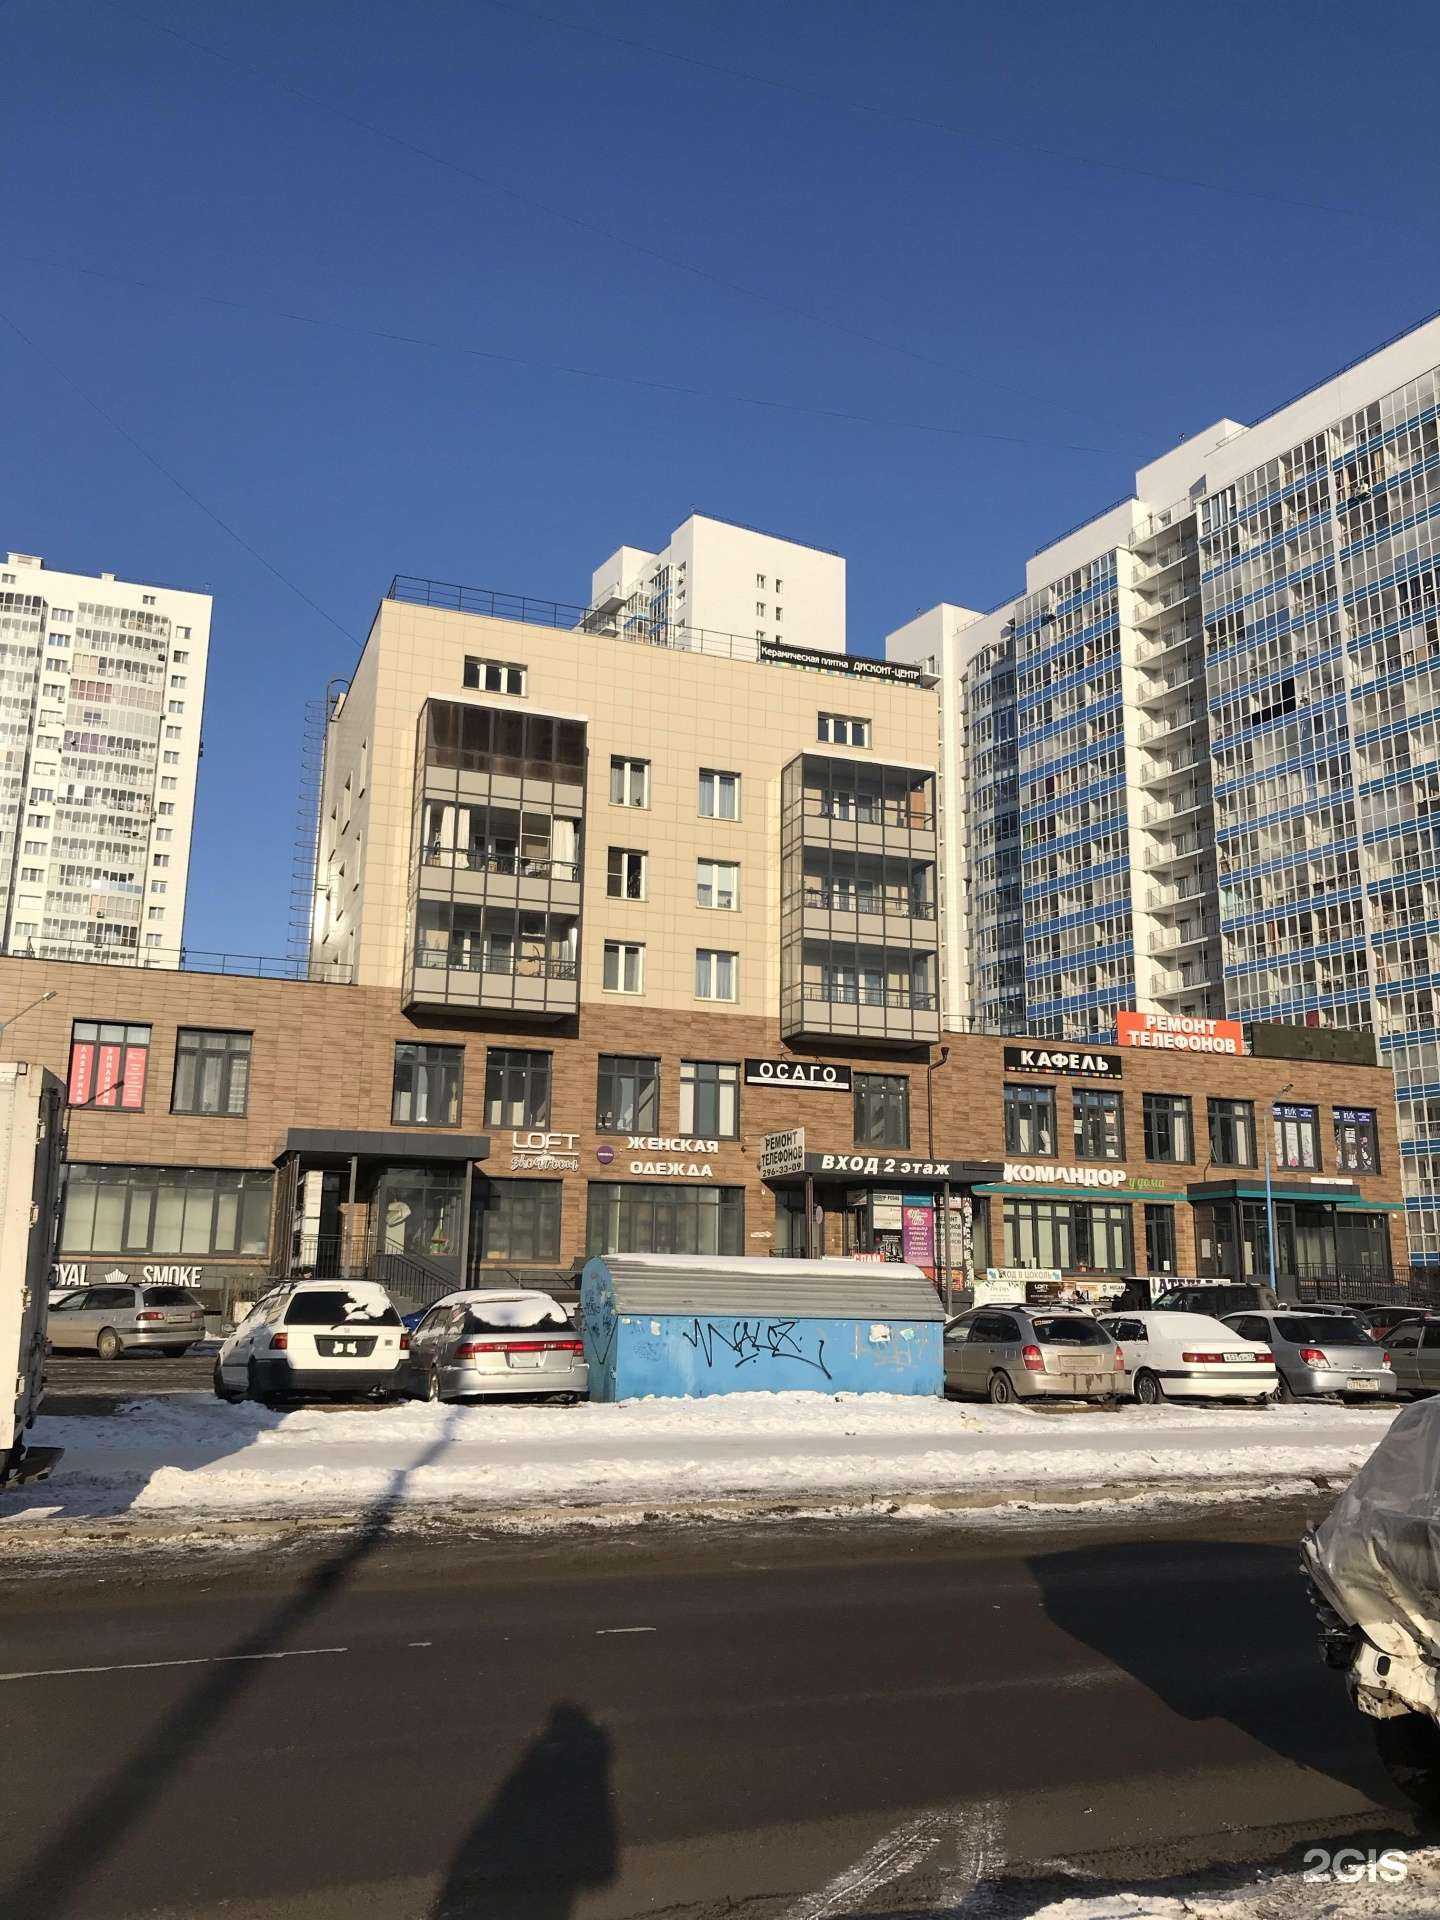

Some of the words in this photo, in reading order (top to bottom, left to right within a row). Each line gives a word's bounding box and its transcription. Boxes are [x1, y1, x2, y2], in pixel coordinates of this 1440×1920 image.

[761, 646, 820, 664] Керамическая
[821, 657, 849, 668] плитка
[1146, 1015, 1217, 1035] РЕМОНТ
[1128, 1030, 1236, 1054] ТЕЛЕФОНОВ
[1020, 1050, 1109, 1072] КАФЕЛЬ
[759, 1062, 837, 1082] ОСАГО
[513, 1131, 580, 1150] LOFT
[626, 1136, 719, 1154] ЖЕНСКАЯ
[765, 1130, 798, 1151] РЕМОНТ
[762, 1145, 803, 1167] ТЕЛЕФОНОВ
[821, 1154, 879, 1175] ВХОД
[883, 1158, 896, 1173] 2
[900, 1162, 950, 1176] этаж
[629, 1161, 713, 1178] ОДЕЖДА
[762, 1161, 802, 1178] 296-33-09
[1003, 1162, 1127, 1188] КОМАНДОР
[142, 1265, 202, 1288] SMOKE
